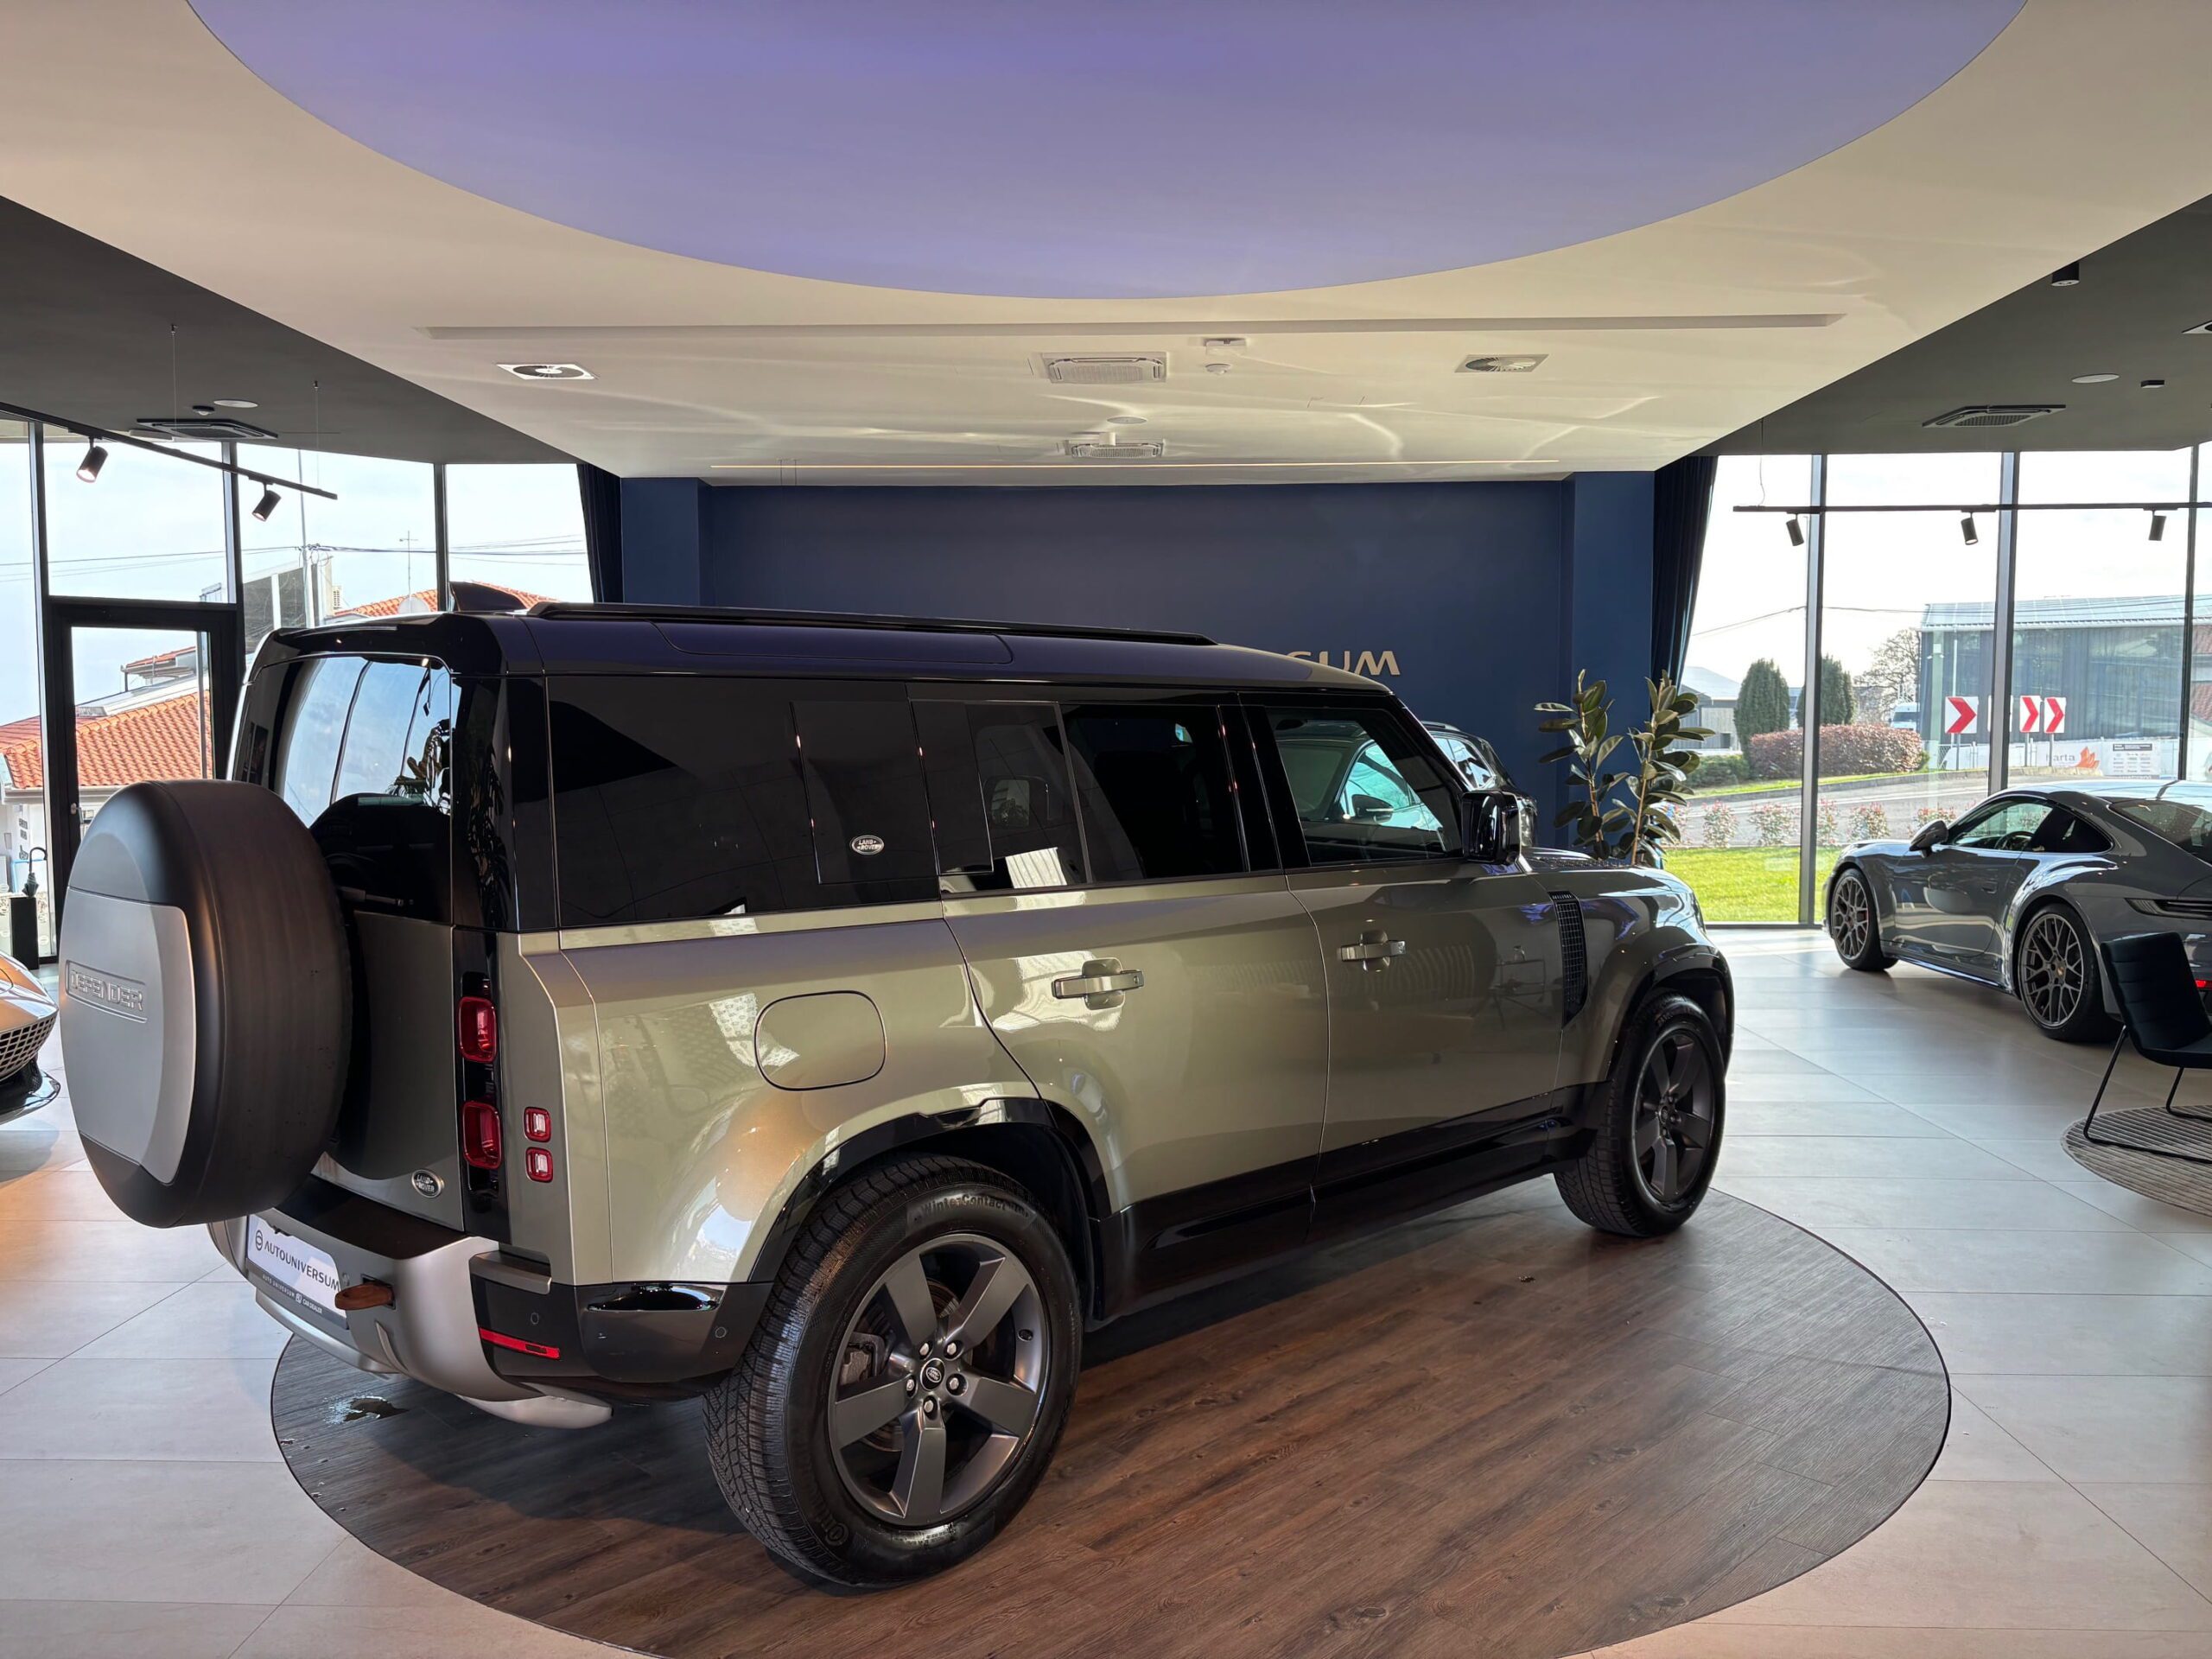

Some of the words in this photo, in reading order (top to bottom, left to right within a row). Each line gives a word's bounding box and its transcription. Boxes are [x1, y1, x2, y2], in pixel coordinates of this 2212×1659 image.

[1287, 651, 1401, 676] UM
[70, 969, 143, 1012] DEFENDER
[264, 1241, 340, 1292] AUTOUNIVERSUM
